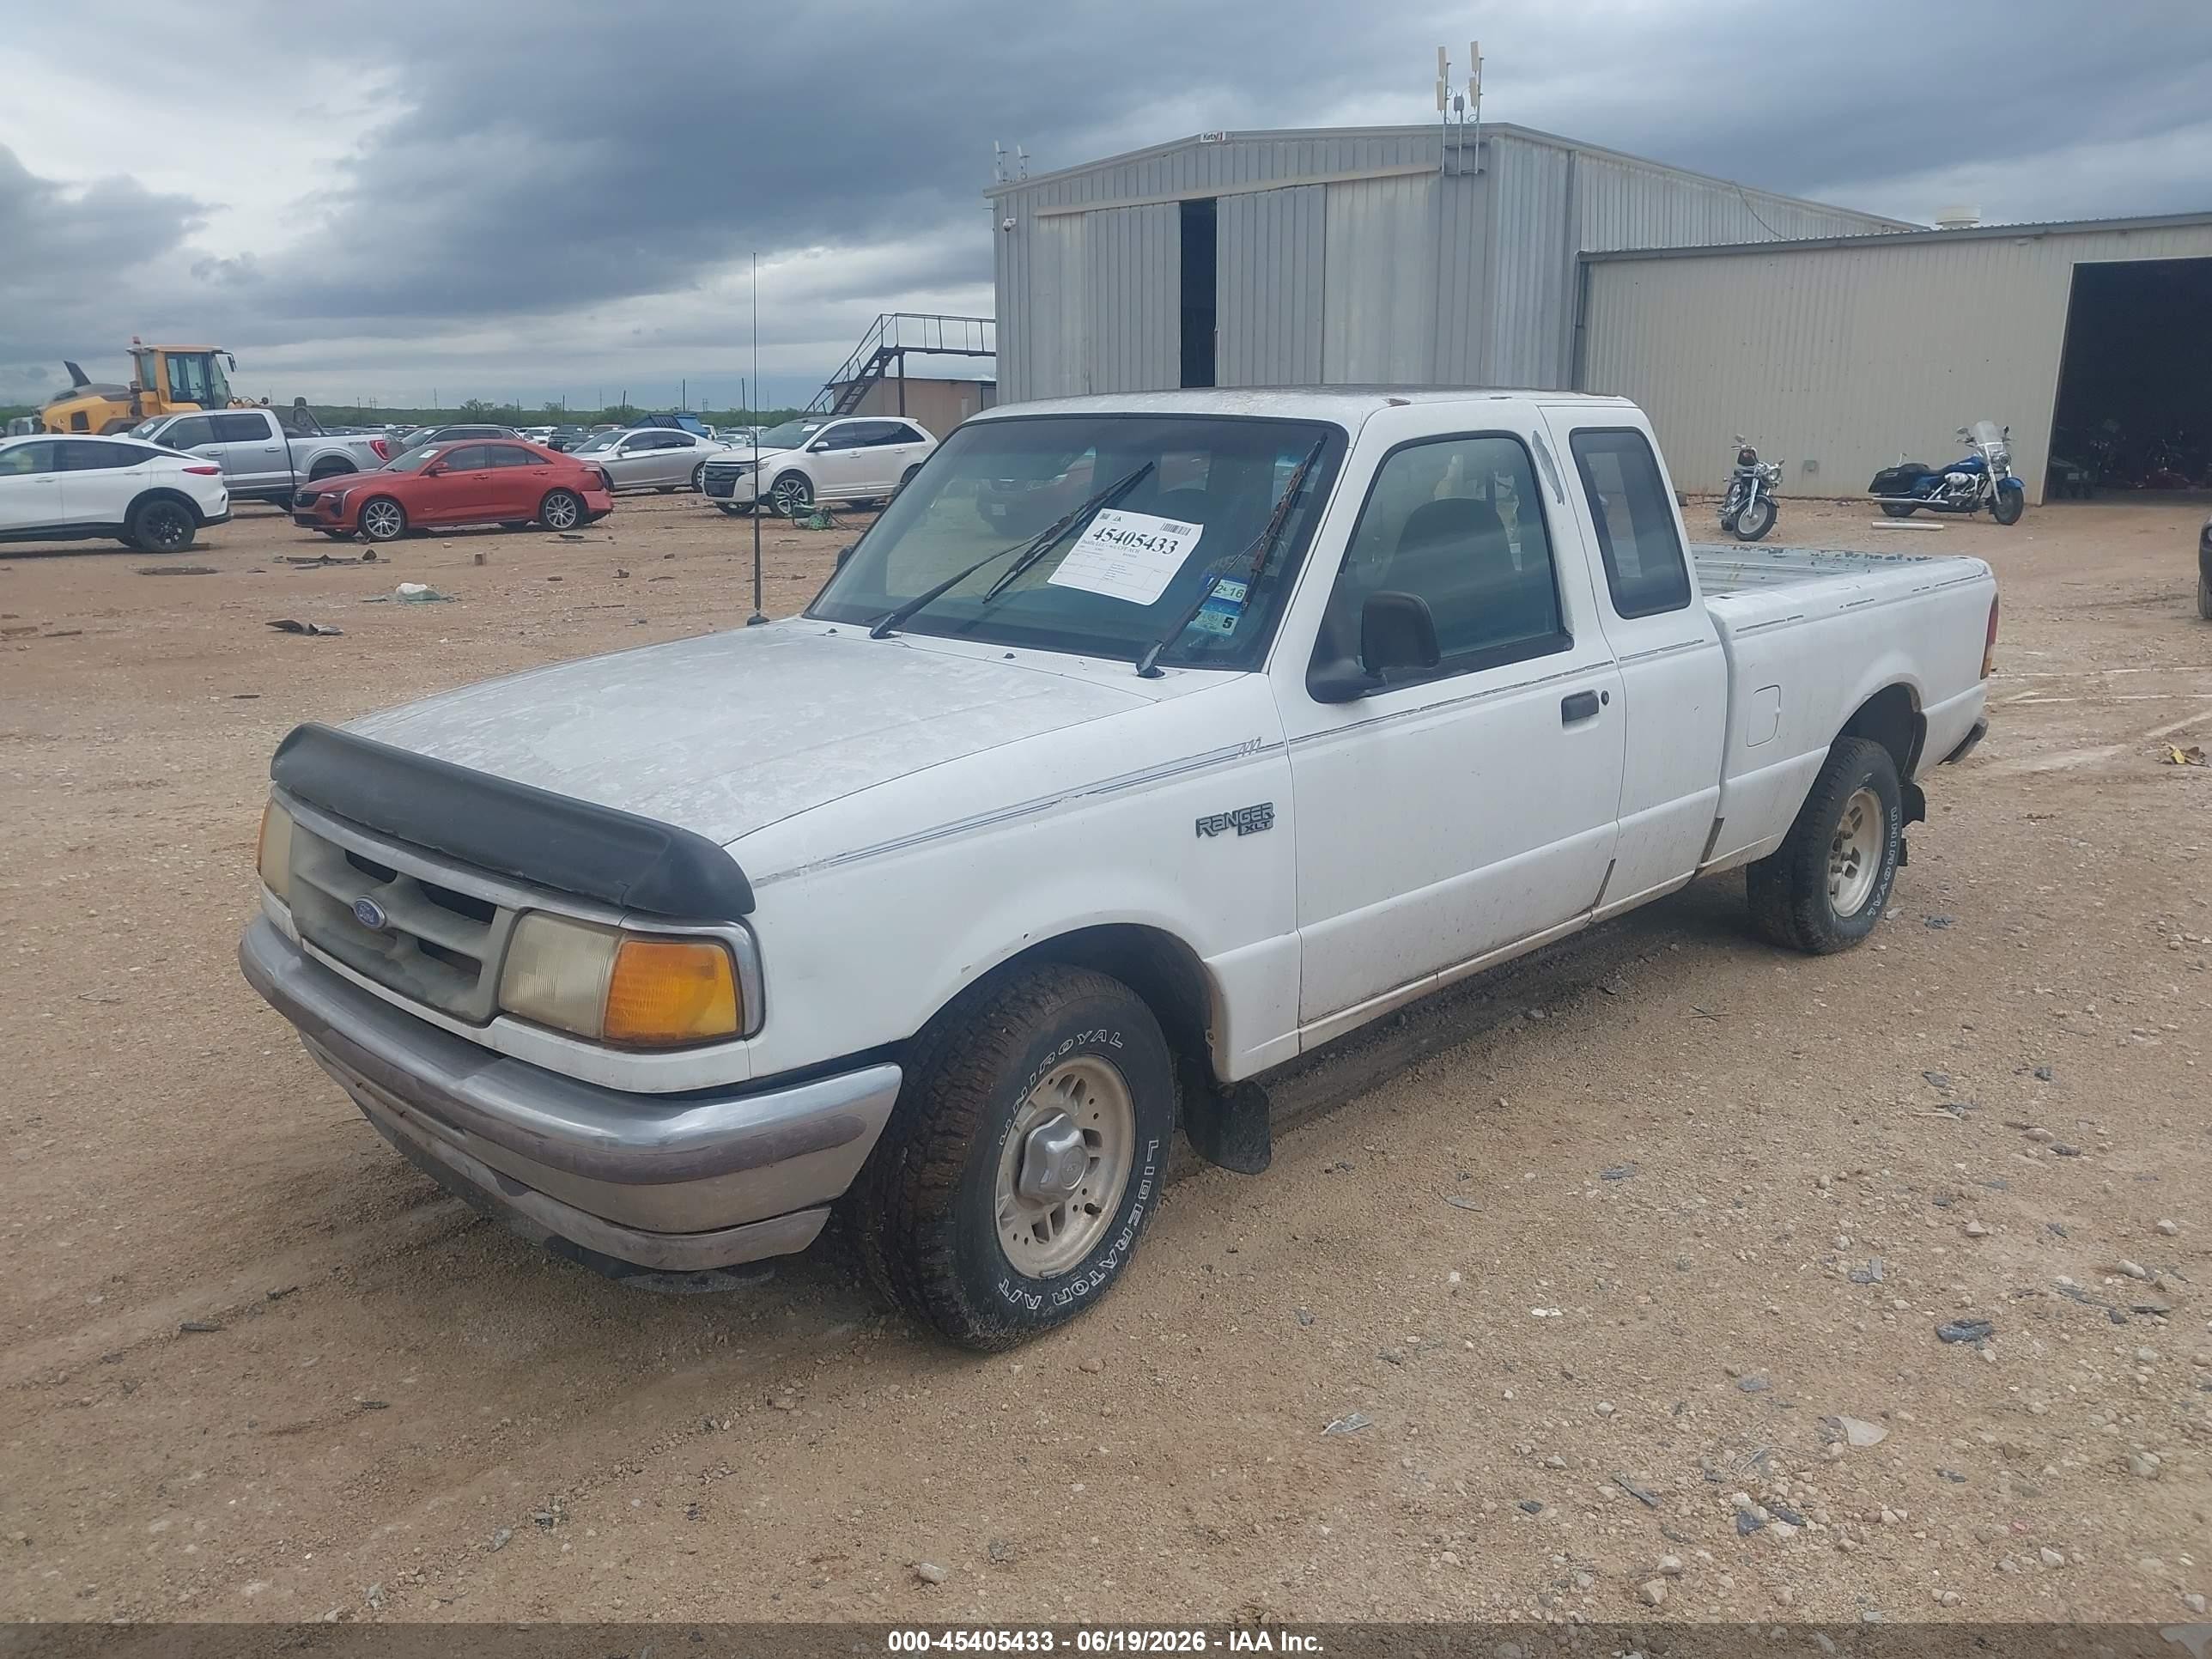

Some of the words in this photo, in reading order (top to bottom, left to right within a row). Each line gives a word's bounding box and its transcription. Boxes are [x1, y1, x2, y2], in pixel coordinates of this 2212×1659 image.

[1093, 527, 1179, 555] 45405433
[1230, 587, 1244, 599] 16
[1222, 617, 1235, 629] 5
[1196, 802, 1275, 838] RANGER
[1243, 819, 1272, 834] XLT
[358, 902, 376, 923] Ford
[999, 1029, 1125, 1146] UNIROYAL
[1053, 1139, 1159, 1306] LIBERATOR
[998, 1278, 1043, 1310] A/T
